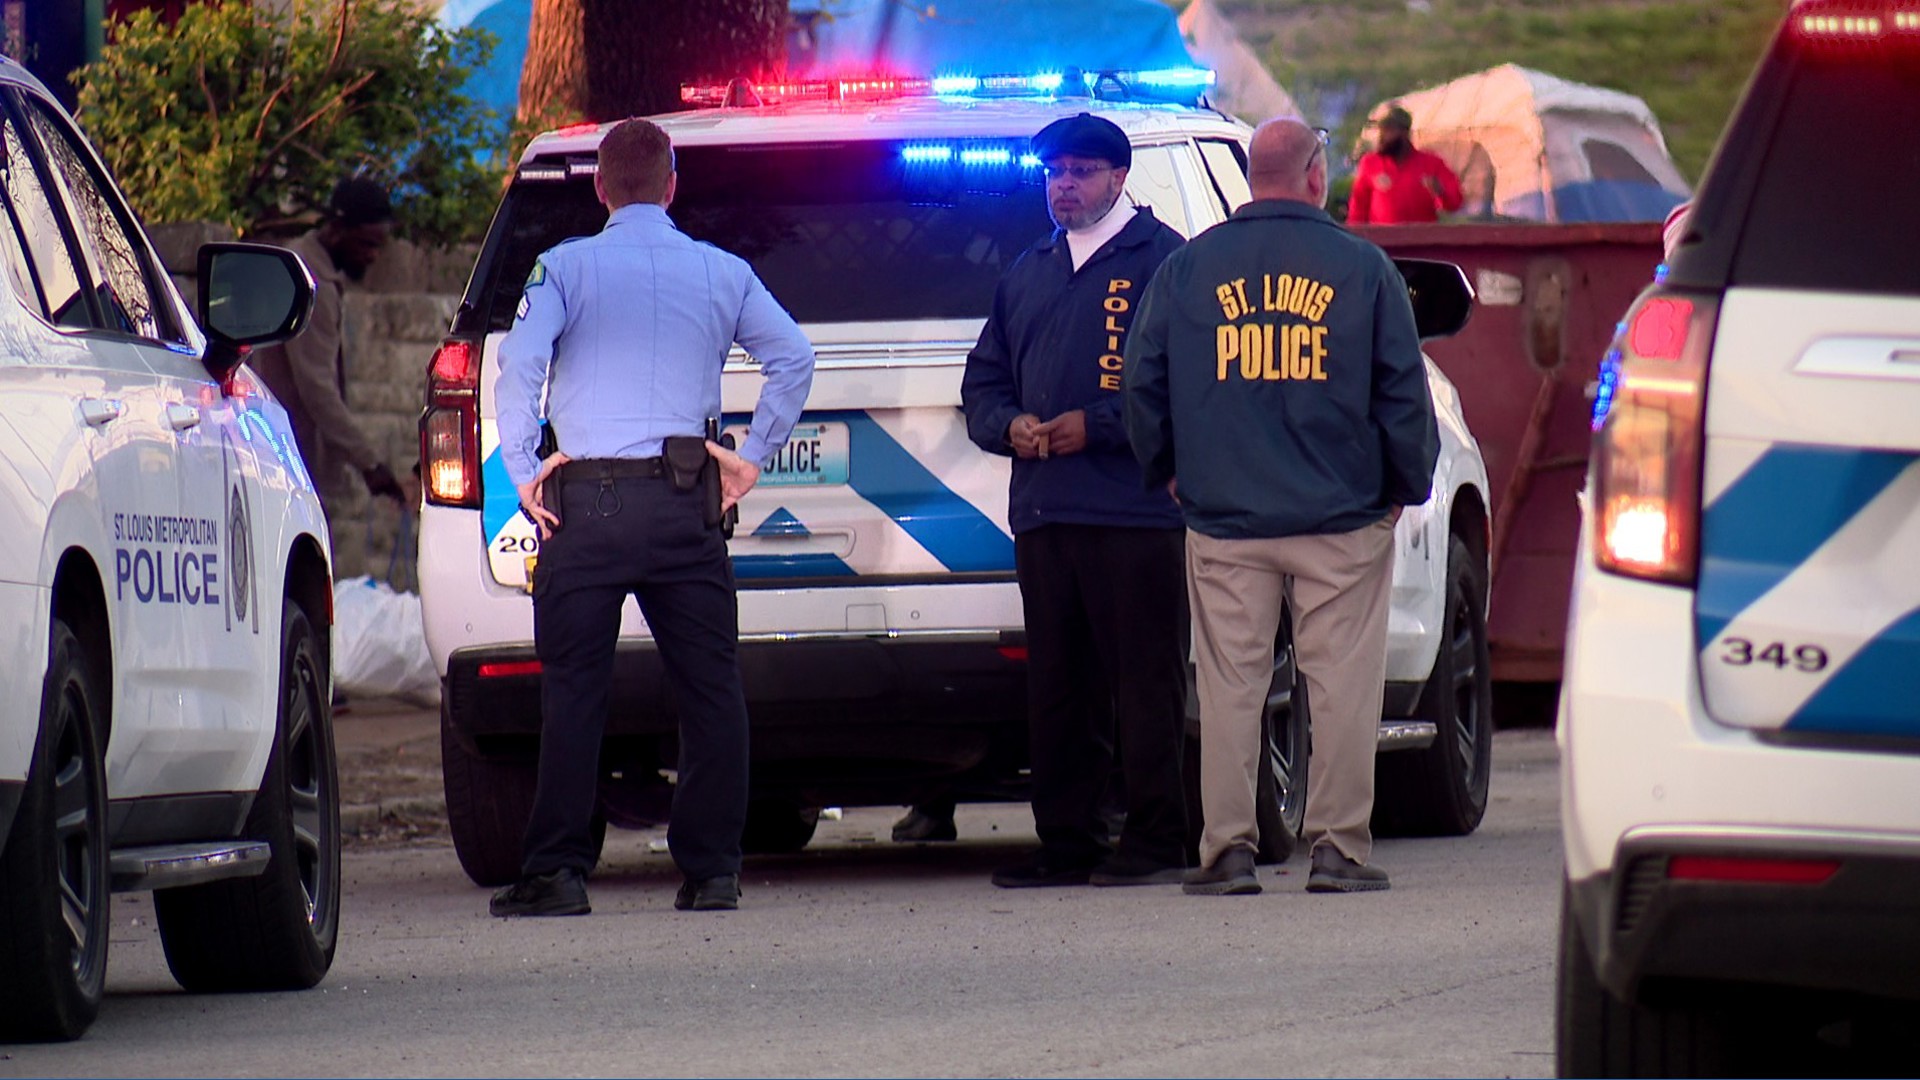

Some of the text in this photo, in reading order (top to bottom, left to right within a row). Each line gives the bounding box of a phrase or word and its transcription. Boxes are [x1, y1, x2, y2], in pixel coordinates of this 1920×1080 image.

[1216, 273, 1335, 322] ST. LOUIS
[1099, 279, 1132, 391] POLICE
[1216, 323, 1329, 381] POLICE
[764, 440, 821, 473] LICE
[114, 512, 218, 546] ST. LOUIS METROPOLITAN
[116, 548, 219, 605] POLICE
[1721, 637, 1828, 673] 349
